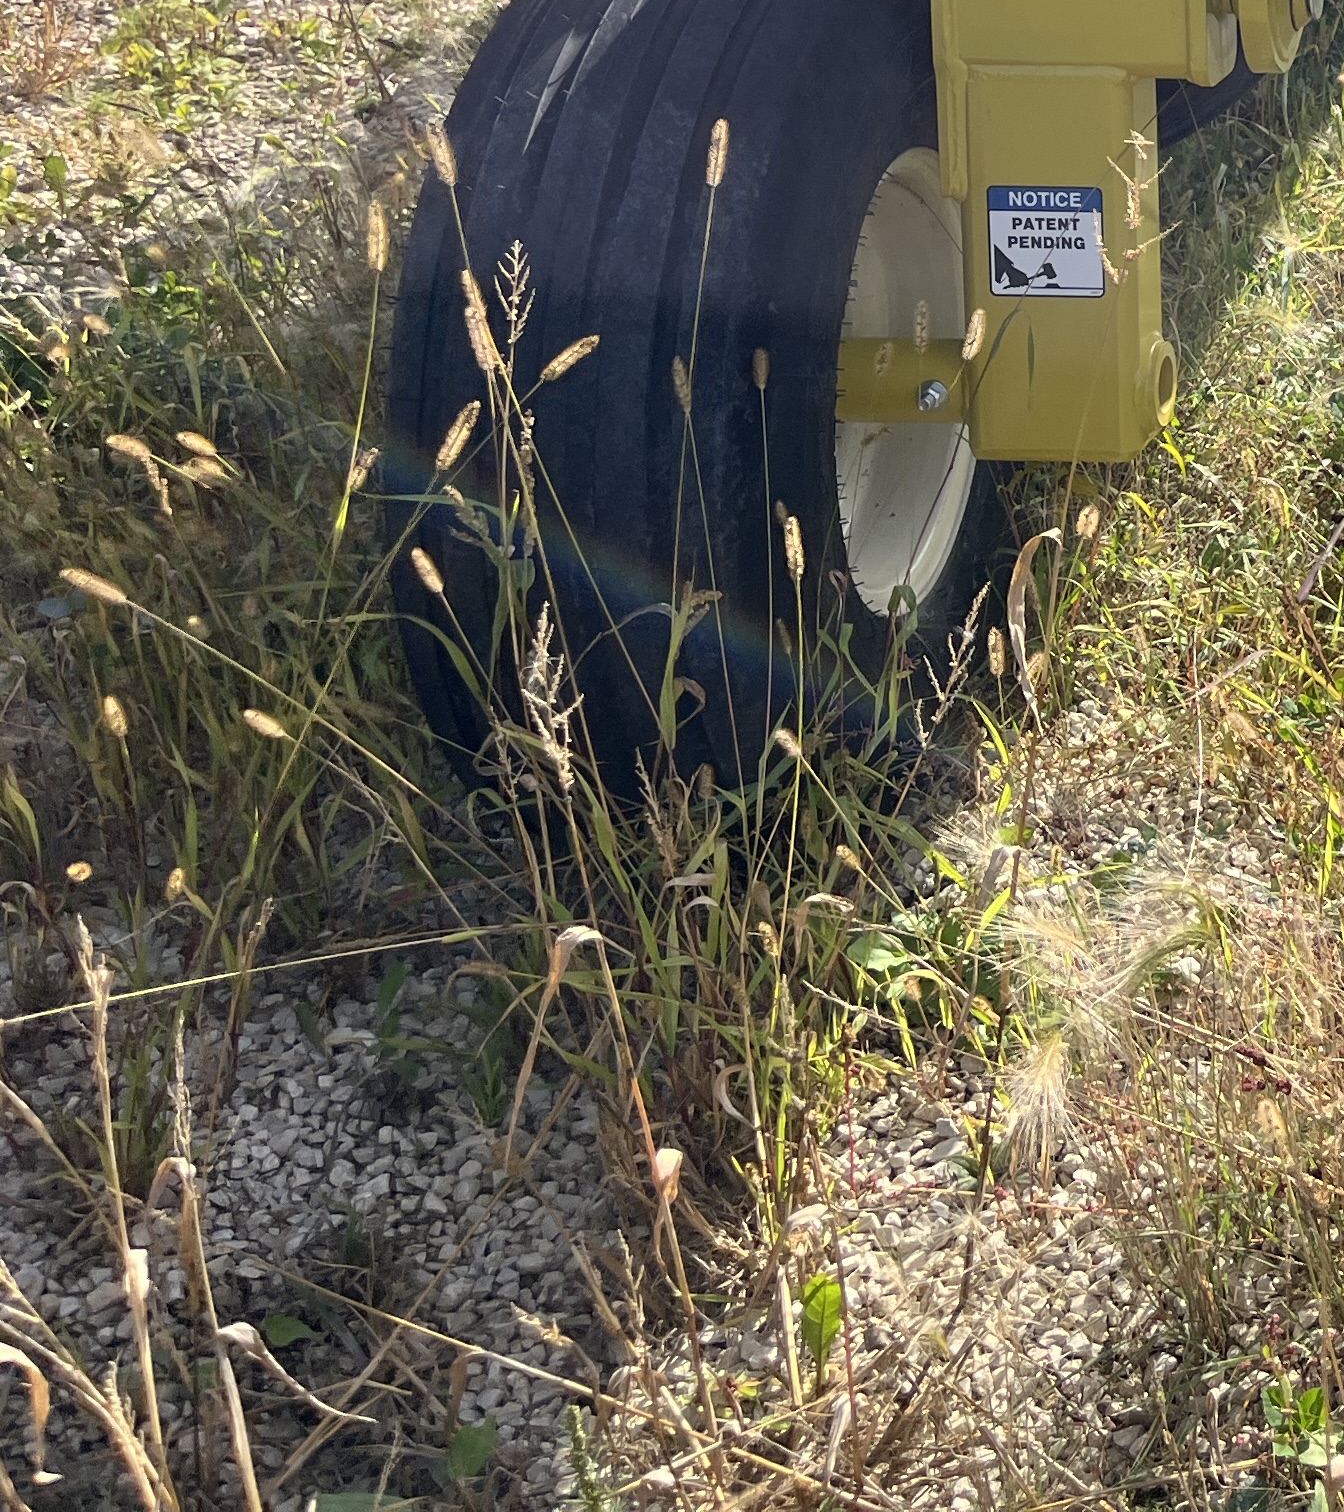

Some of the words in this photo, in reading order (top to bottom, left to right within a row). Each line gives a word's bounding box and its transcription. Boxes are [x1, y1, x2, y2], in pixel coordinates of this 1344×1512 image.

[1008, 191, 1082, 208] NOTICE
[1012, 217, 1080, 231] PATENT
[1007, 235, 1086, 250] PENDING
